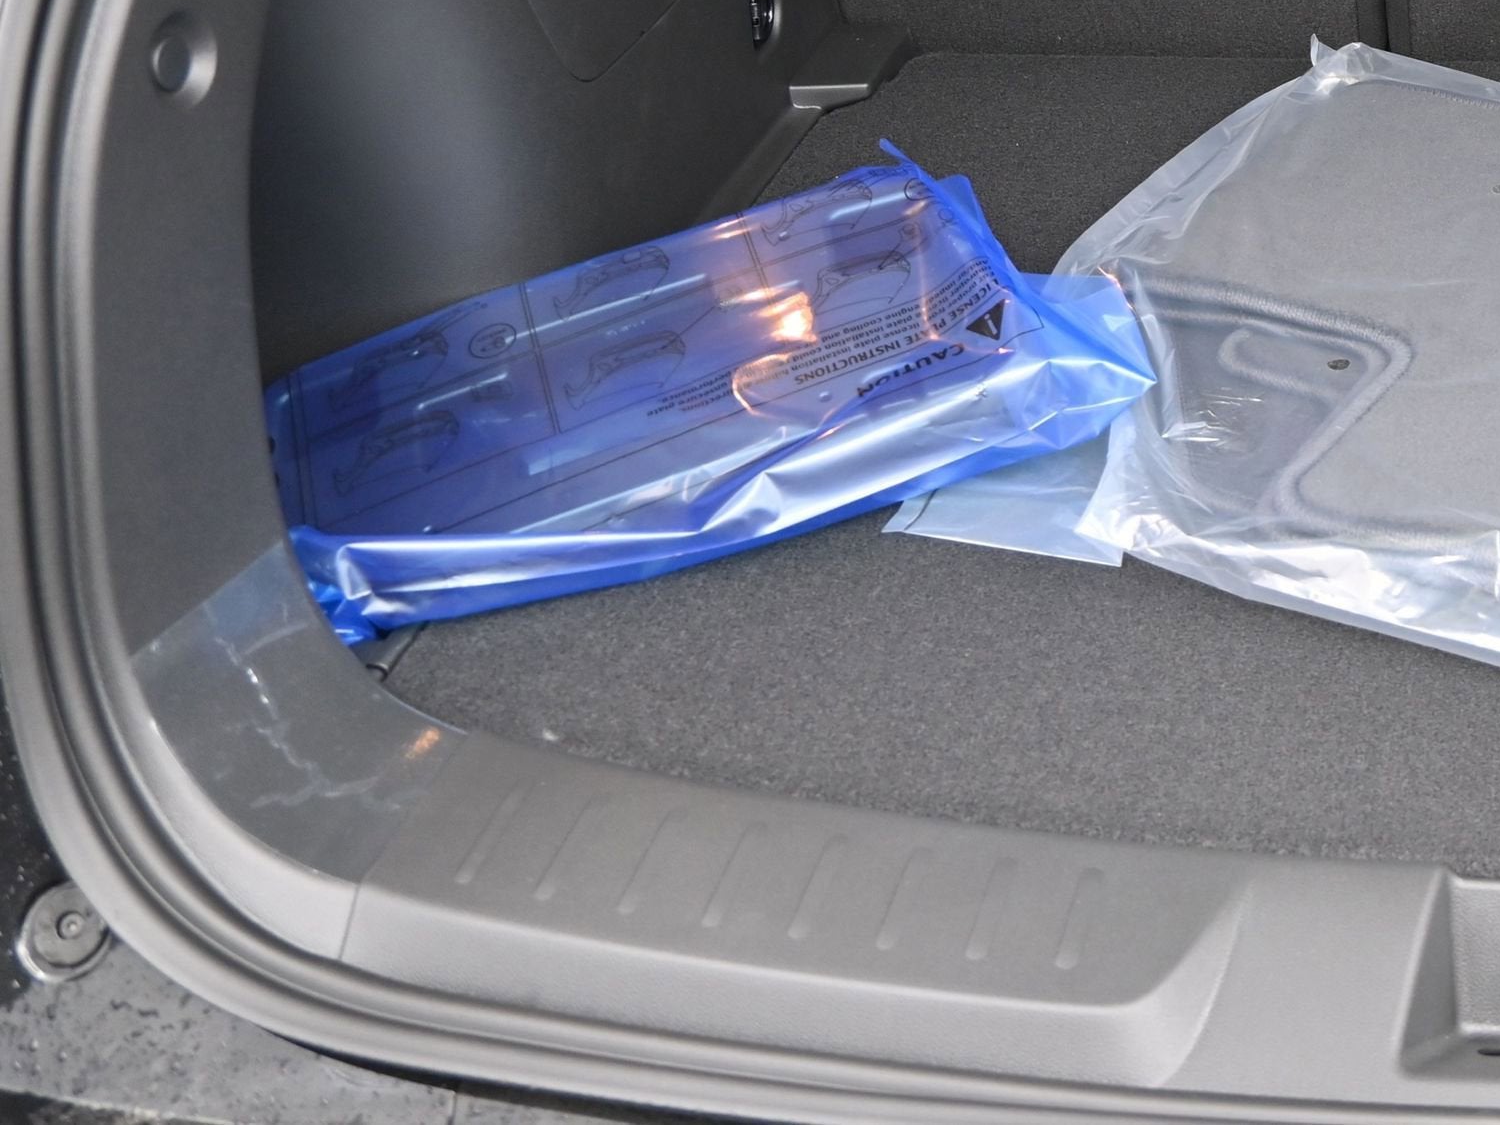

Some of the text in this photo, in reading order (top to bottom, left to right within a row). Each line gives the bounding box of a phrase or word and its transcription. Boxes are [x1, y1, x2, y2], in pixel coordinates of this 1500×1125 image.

[950, 279, 999, 321] LICENSE
[886, 303, 920, 320] engine
[843, 318, 882, 335] cooling
[884, 322, 920, 339] license
[890, 316, 917, 328] plate
[821, 332, 841, 343] and
[825, 325, 884, 350] installation
[854, 335, 881, 347] plate
[791, 344, 851, 371] installation
[792, 346, 822, 362] could
[794, 339, 902, 385] INSTRUCTIONS
[857, 343, 965, 397] CAUTION
